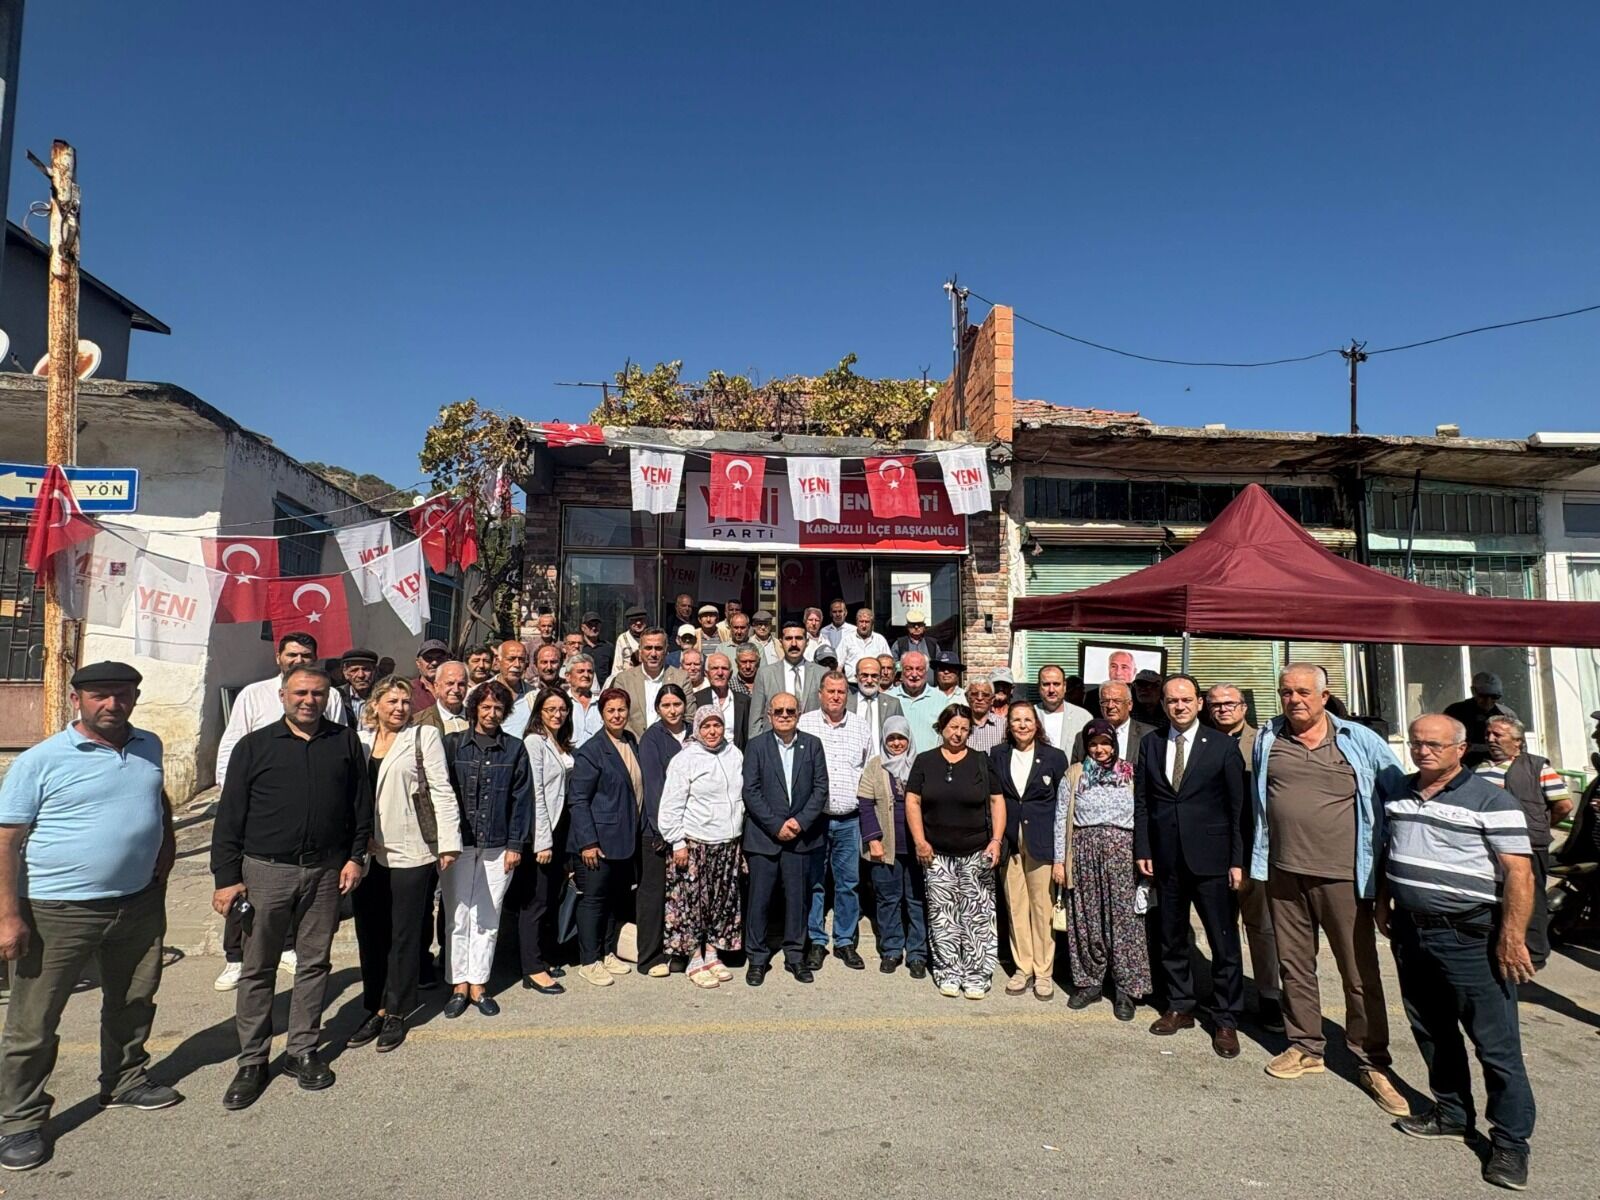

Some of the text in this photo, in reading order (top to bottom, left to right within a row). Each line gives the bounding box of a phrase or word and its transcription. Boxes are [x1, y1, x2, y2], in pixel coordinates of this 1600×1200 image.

[86, 482, 123, 495] YÖN
[806, 522, 959, 537] KARPUZLU İLÇE BAŞKANLIĞI
